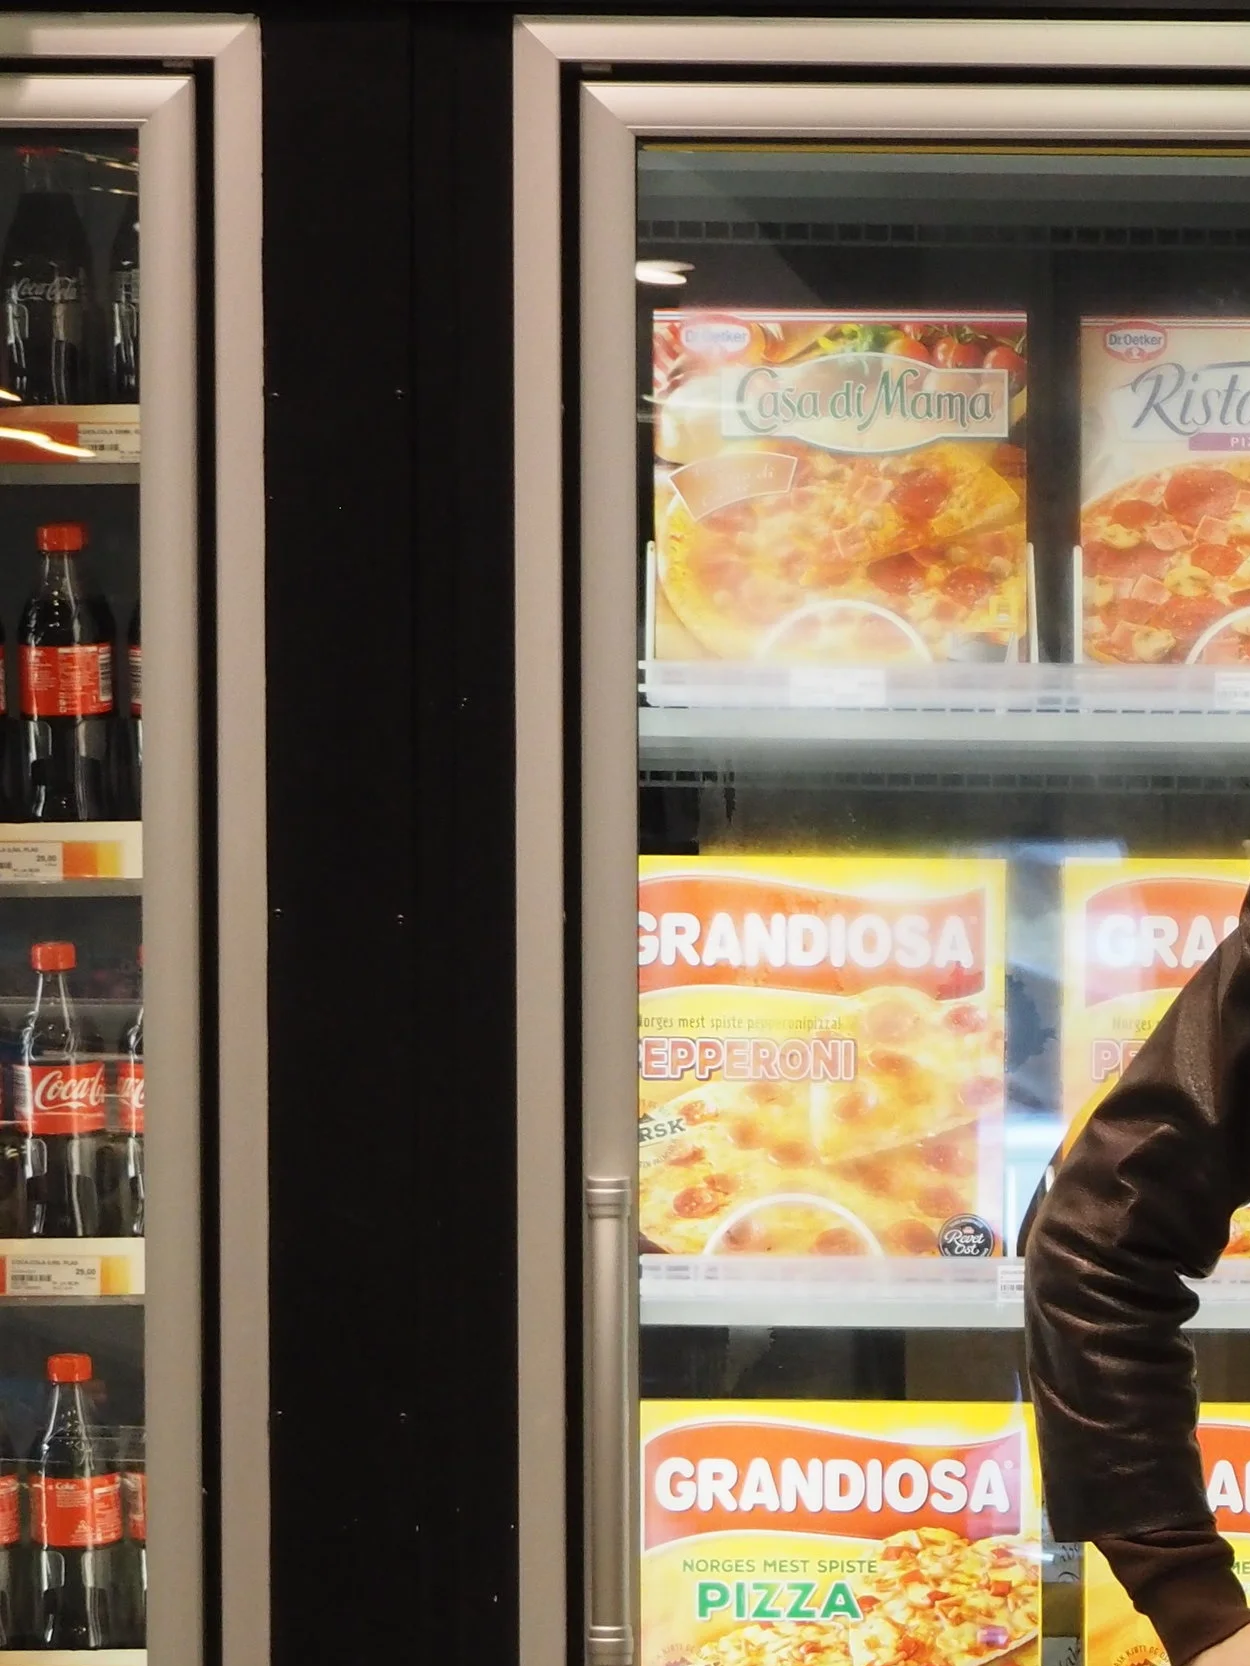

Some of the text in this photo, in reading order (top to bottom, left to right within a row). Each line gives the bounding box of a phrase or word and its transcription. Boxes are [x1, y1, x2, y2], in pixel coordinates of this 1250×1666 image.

[736, 367, 993, 434] Casa di Mama
[638, 1014, 674, 1031] orges
[678, 1015, 705, 1029] mest
[710, 1014, 744, 1031] spiste
[638, 1036, 858, 1081] EPPERONI
[638, 1118, 686, 1143] RSK
[654, 1456, 1010, 1514] GRANDIOSA
[682, 1559, 878, 1574] NORGES MEST SPISTE
[697, 1581, 864, 1622] PIZZA
